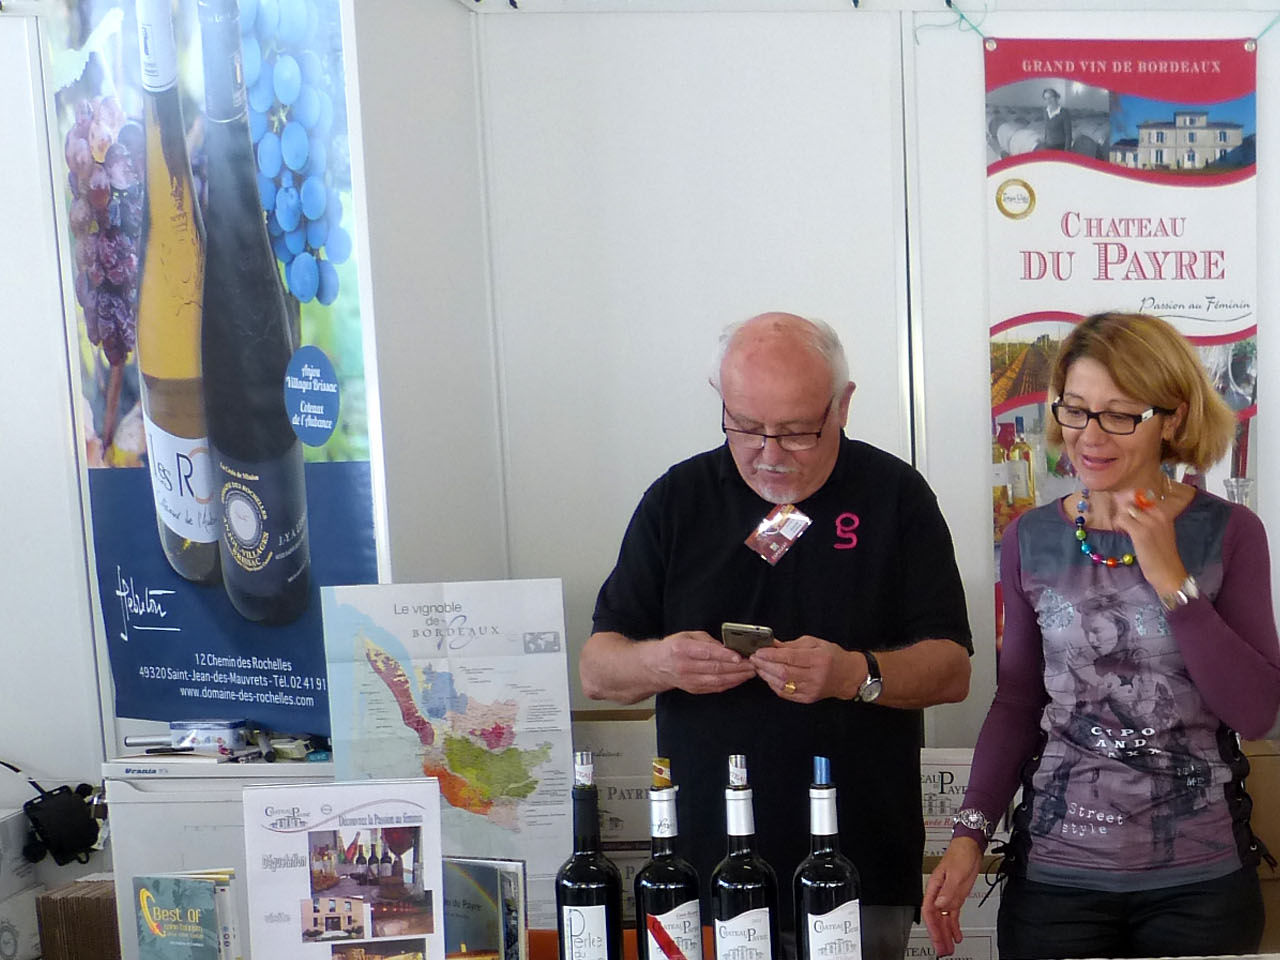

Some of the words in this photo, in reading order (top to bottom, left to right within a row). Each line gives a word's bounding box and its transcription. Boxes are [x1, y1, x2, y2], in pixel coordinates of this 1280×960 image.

[1021, 60, 1075, 73] GRAND
[1080, 60, 1107, 73] VIN
[1112, 61, 1133, 73] DE
[1137, 60, 1222, 74] BORDEAUX
[1060, 211, 1187, 239] CHATEAU
[1019, 250, 1076, 281] DU
[1092, 241, 1226, 281] PAYRE
[1138, 296, 1186, 313] Passion
[394, 603, 409, 615] Le
[412, 602, 462, 616] vignoble
[425, 616, 440, 626] de
[412, 626, 500, 639] BORDEAUX
[195, 652, 207, 665] 12
[207, 654, 236, 669] Chemin
[237, 656, 251, 669] des
[252, 657, 293, 672] Rochelles
[138, 666, 167, 680] 49320
[167, 668, 268, 687] Saint-Jean-des-Mauvrets
[179, 686, 315, 707] www.domaine-des-rochelles.com
[1068, 802, 1124, 825] Street
[1061, 823, 1108, 837] style
[153, 906, 182, 922] Best
